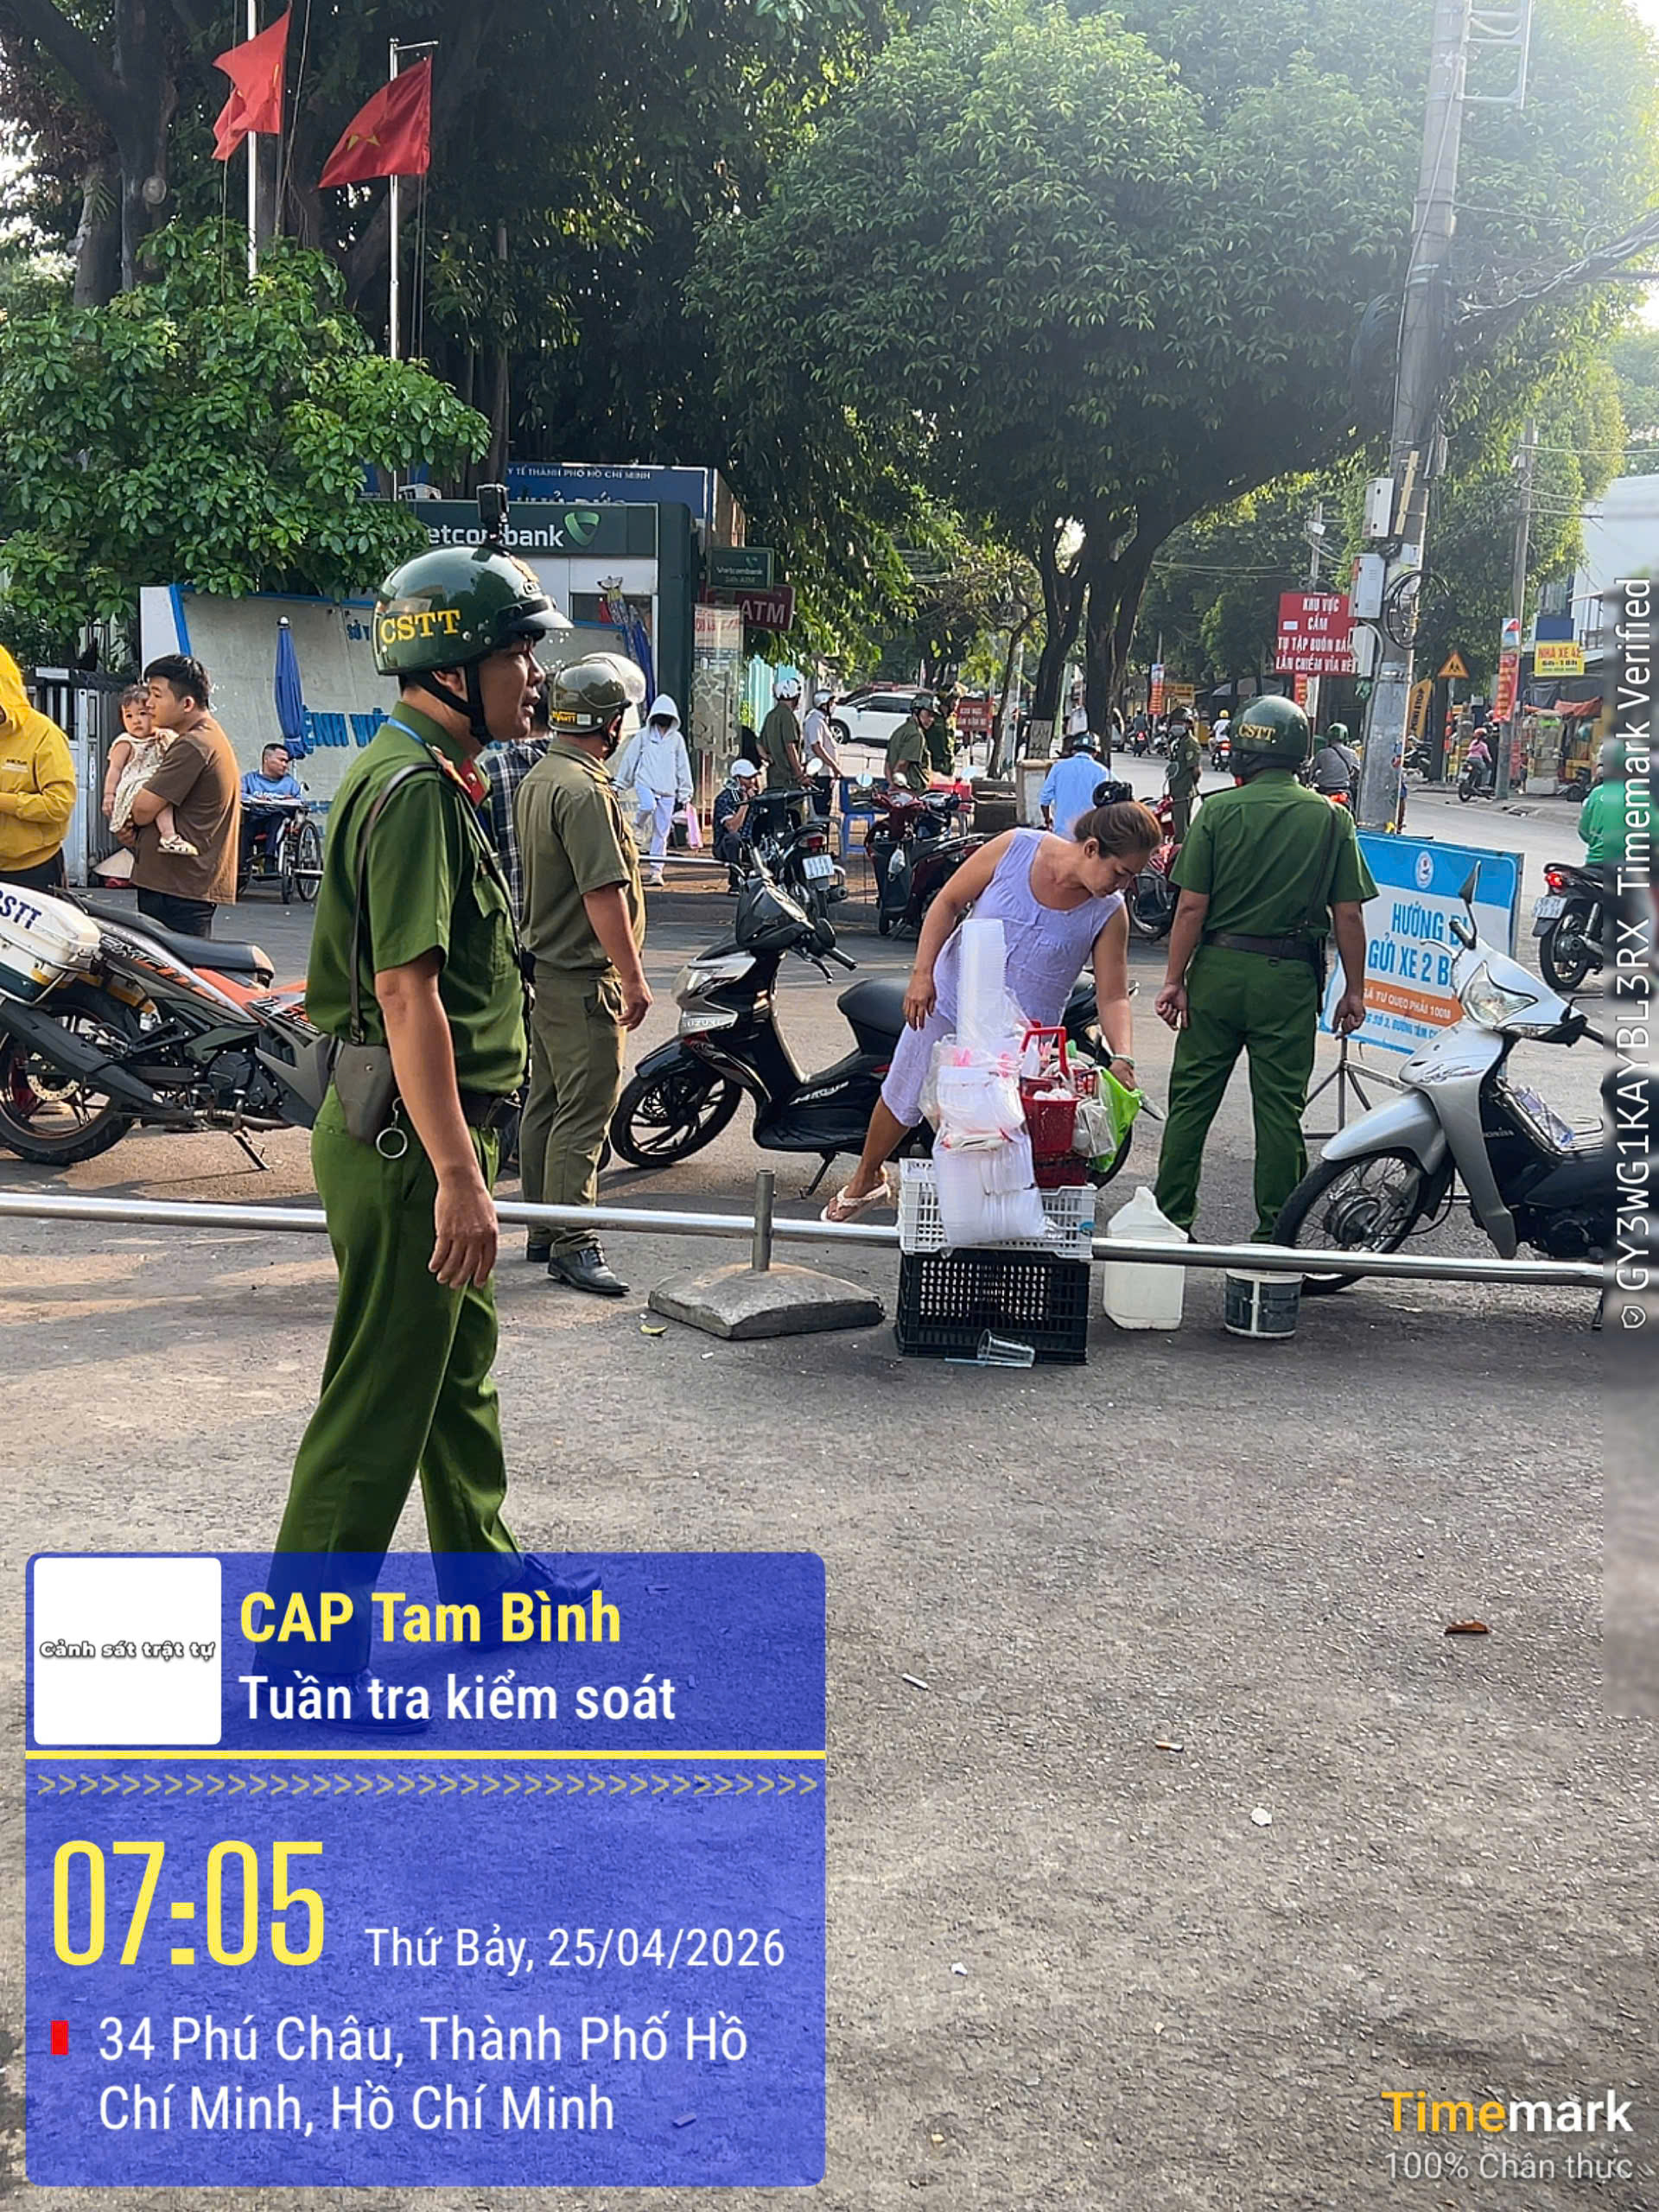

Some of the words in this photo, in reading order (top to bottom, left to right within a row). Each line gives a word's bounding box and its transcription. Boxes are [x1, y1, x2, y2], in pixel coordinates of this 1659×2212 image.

[741, 599, 785, 625] ATM
[1302, 597, 1320, 612] KHU
[1322, 596, 1339, 615] VỰC
[380, 609, 461, 645] CSTT
[1307, 612, 1328, 631] CẤM
[1238, 722, 1276, 741] CSTT
[0, 888, 42, 930] STT
[1391, 900, 1445, 942] HƯỚNG
[1368, 931, 1396, 974] GỬI
[1399, 945, 1419, 979] XE
[1421, 952, 1433, 982] 2
